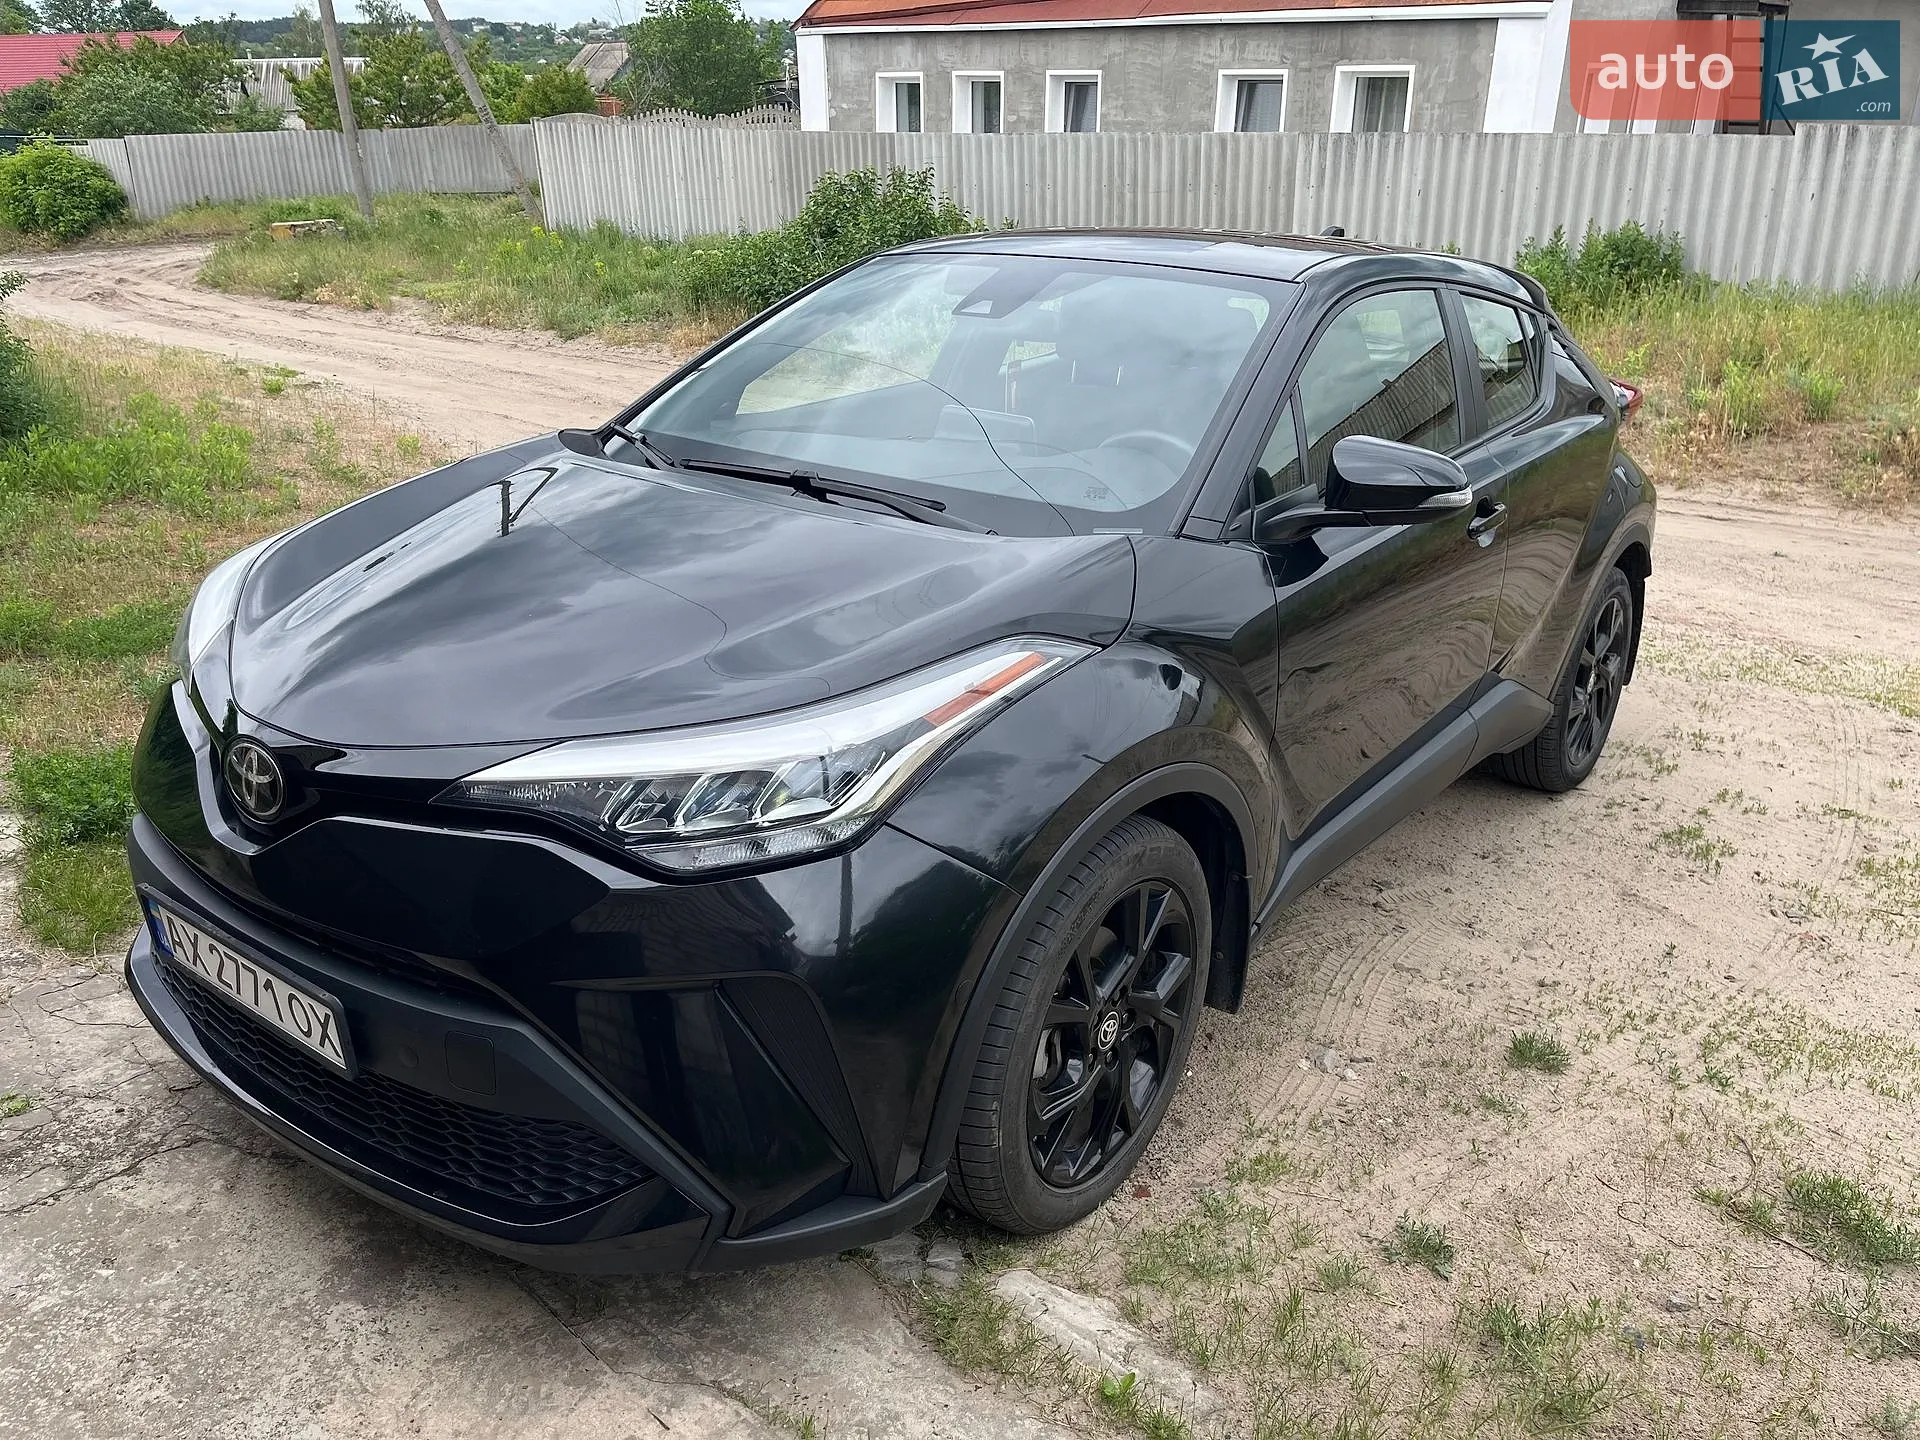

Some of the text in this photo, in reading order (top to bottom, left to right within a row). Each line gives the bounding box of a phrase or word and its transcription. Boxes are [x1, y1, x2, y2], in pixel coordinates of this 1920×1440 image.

[166, 914, 343, 1060] AX 2771 OX
